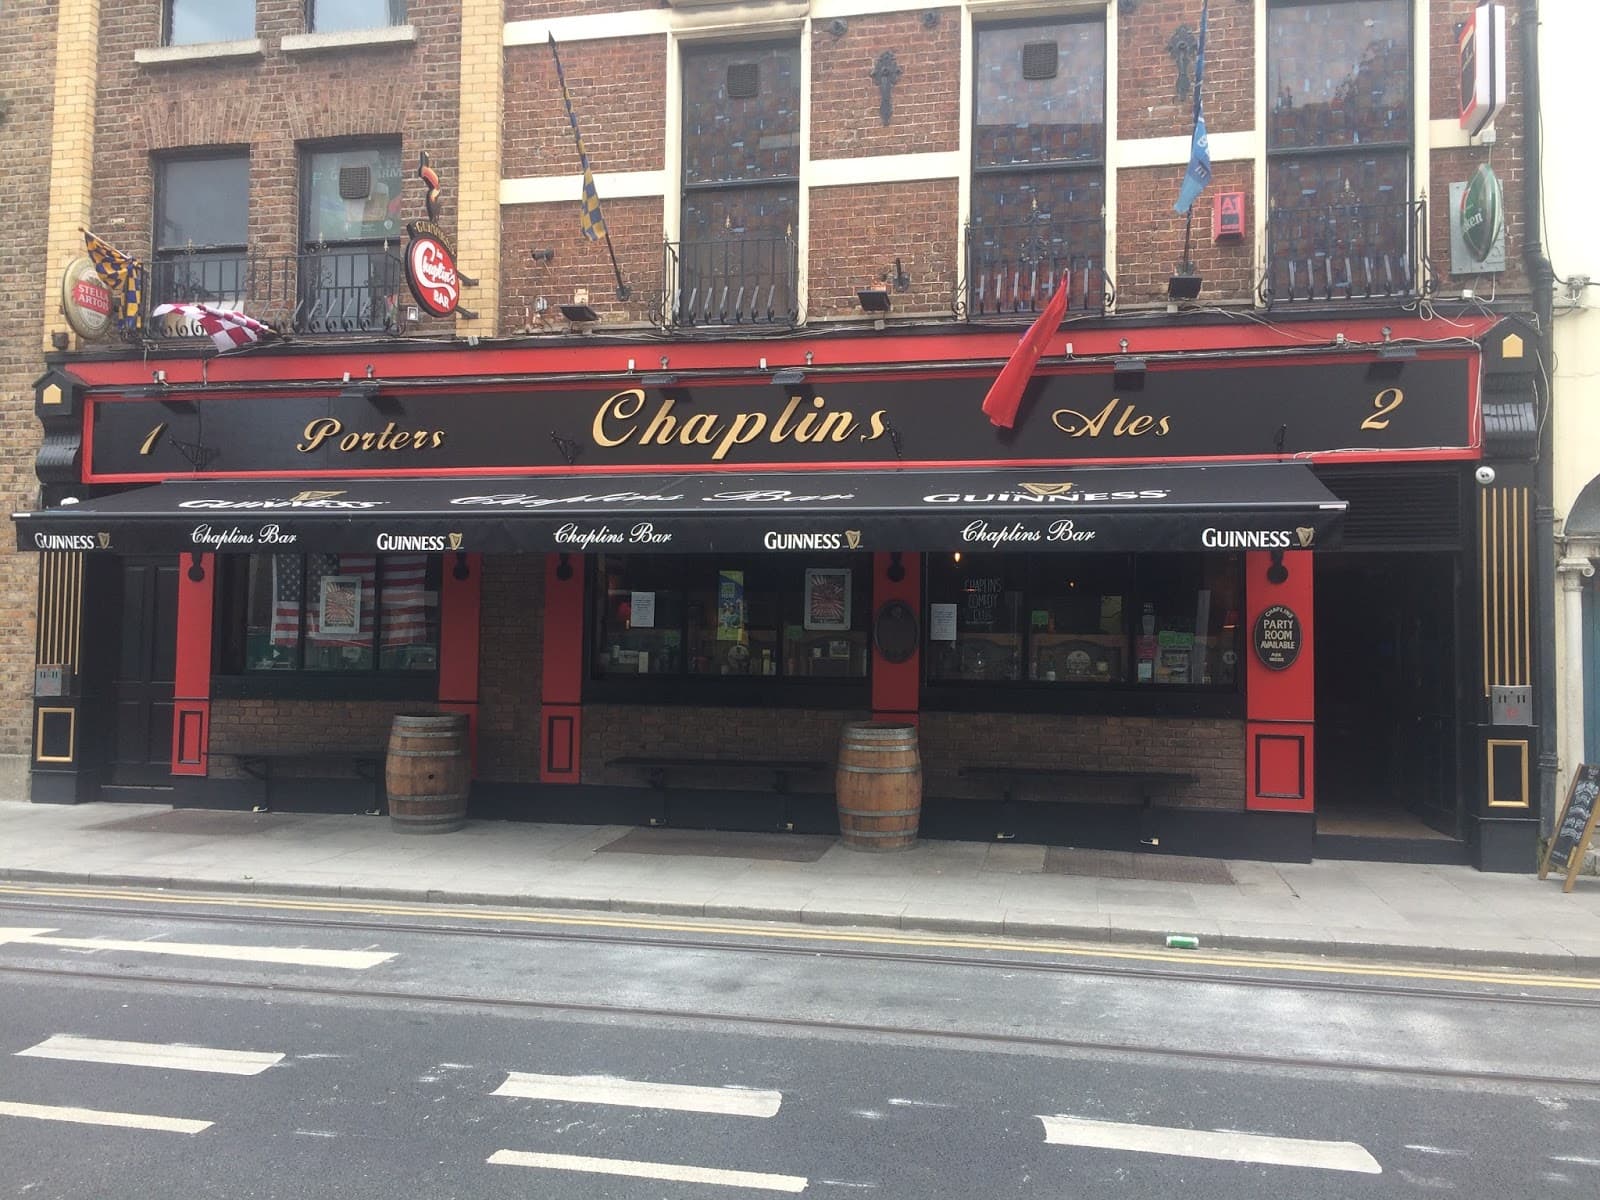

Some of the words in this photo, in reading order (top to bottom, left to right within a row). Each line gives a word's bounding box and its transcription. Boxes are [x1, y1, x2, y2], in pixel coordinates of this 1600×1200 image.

[78, 284, 109, 302] STELLA
[433, 289, 449, 308] BAR
[139, 422, 168, 456] 1
[297, 417, 445, 452] Porters
[592, 388, 888, 460] Chaplins
[1052, 398, 1171, 437] Ales
[1360, 387, 1404, 431] 2
[178, 498, 386, 509] GUINNESS
[702, 490, 855, 502] Bar
[923, 490, 1168, 503] GUINNESS
[34, 532, 95, 549] GUINNESS
[189, 523, 254, 550] Chaplins
[257, 523, 297, 544] Bar
[376, 533, 445, 551] GUINNESS
[553, 522, 625, 550] Chaplins
[628, 522, 672, 543] Bar
[764, 531, 841, 550] GUINNESS
[960, 519, 1041, 549] Chaplins
[1047, 519, 1096, 542] Bar
[1201, 527, 1290, 548] GUINNESS
[1263, 619, 1294, 630] PARTY
[1264, 630, 1293, 641] ROOM
[1260, 640, 1296, 650] AVAILABLE
